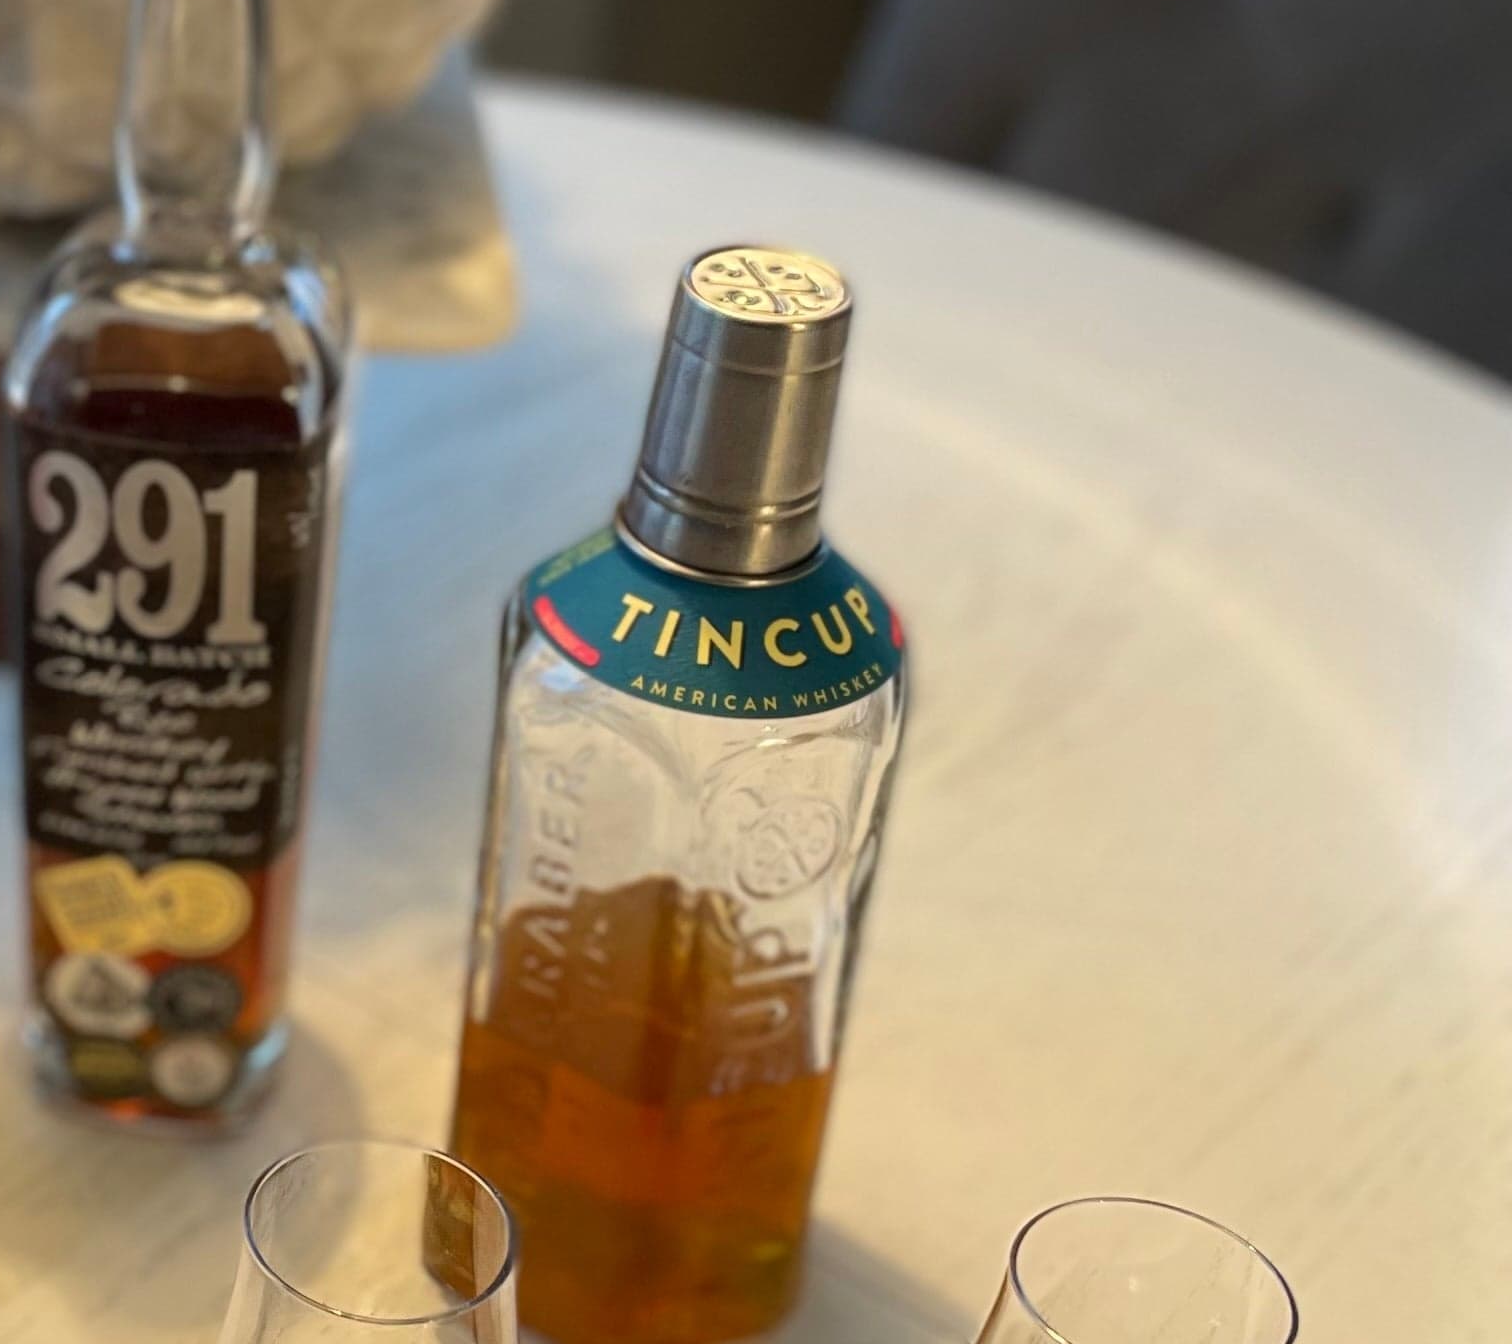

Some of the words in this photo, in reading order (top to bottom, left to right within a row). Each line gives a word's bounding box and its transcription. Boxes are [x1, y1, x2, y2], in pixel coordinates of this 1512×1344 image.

[29, 449, 267, 646] 291
[611, 586, 880, 670] TINCUP
[630, 674, 778, 712] AMERICAN
[792, 662, 884, 708] WHISKEY
